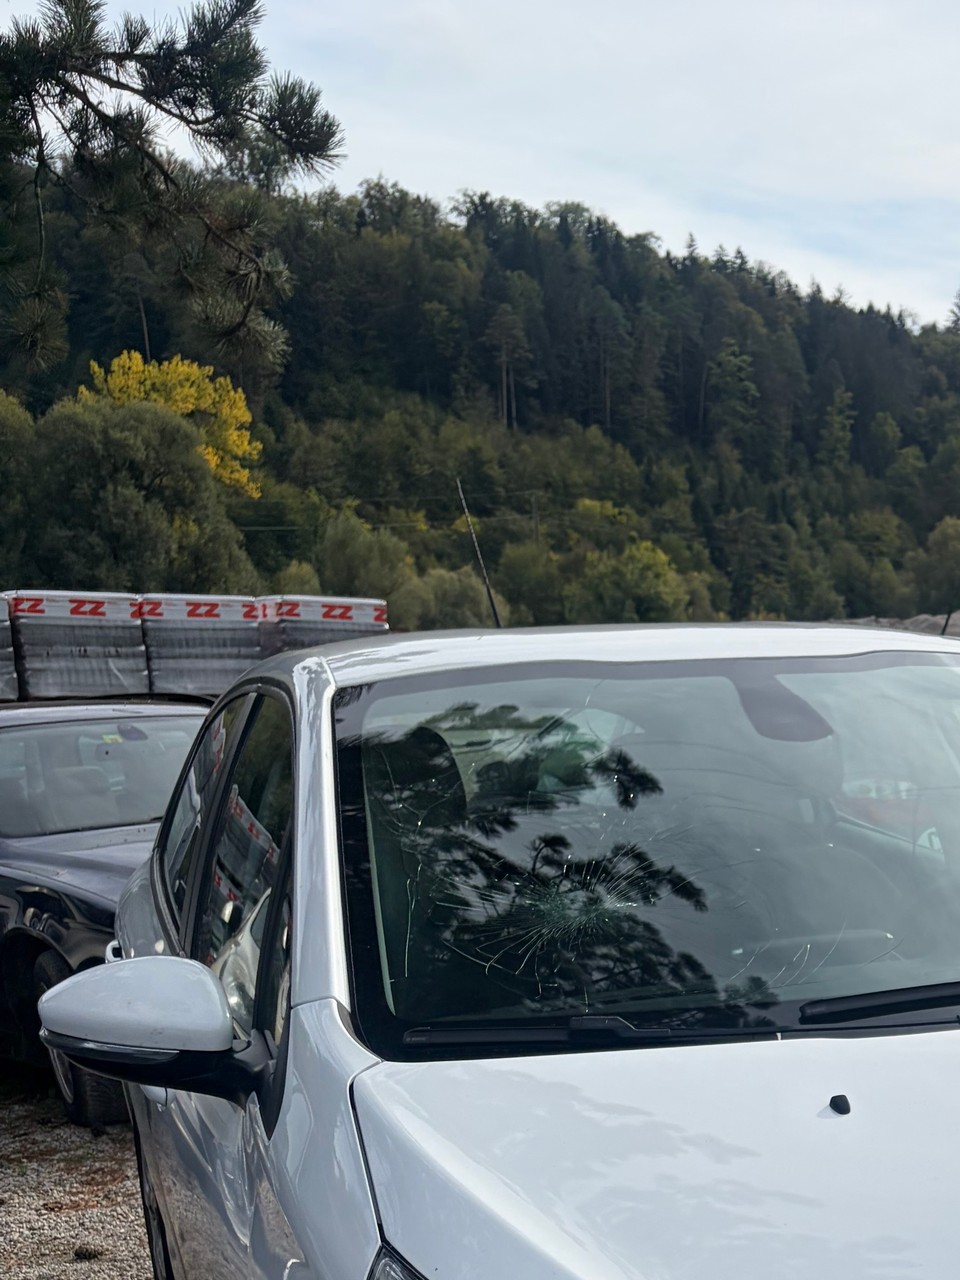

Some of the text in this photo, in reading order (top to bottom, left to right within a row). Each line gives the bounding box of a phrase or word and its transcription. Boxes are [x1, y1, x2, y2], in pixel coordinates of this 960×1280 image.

[12, 597, 45, 614] ZZ
[69, 599, 106, 617] ZZ
[185, 602, 220, 618] ZZ
[321, 604, 353, 620] ZZ
